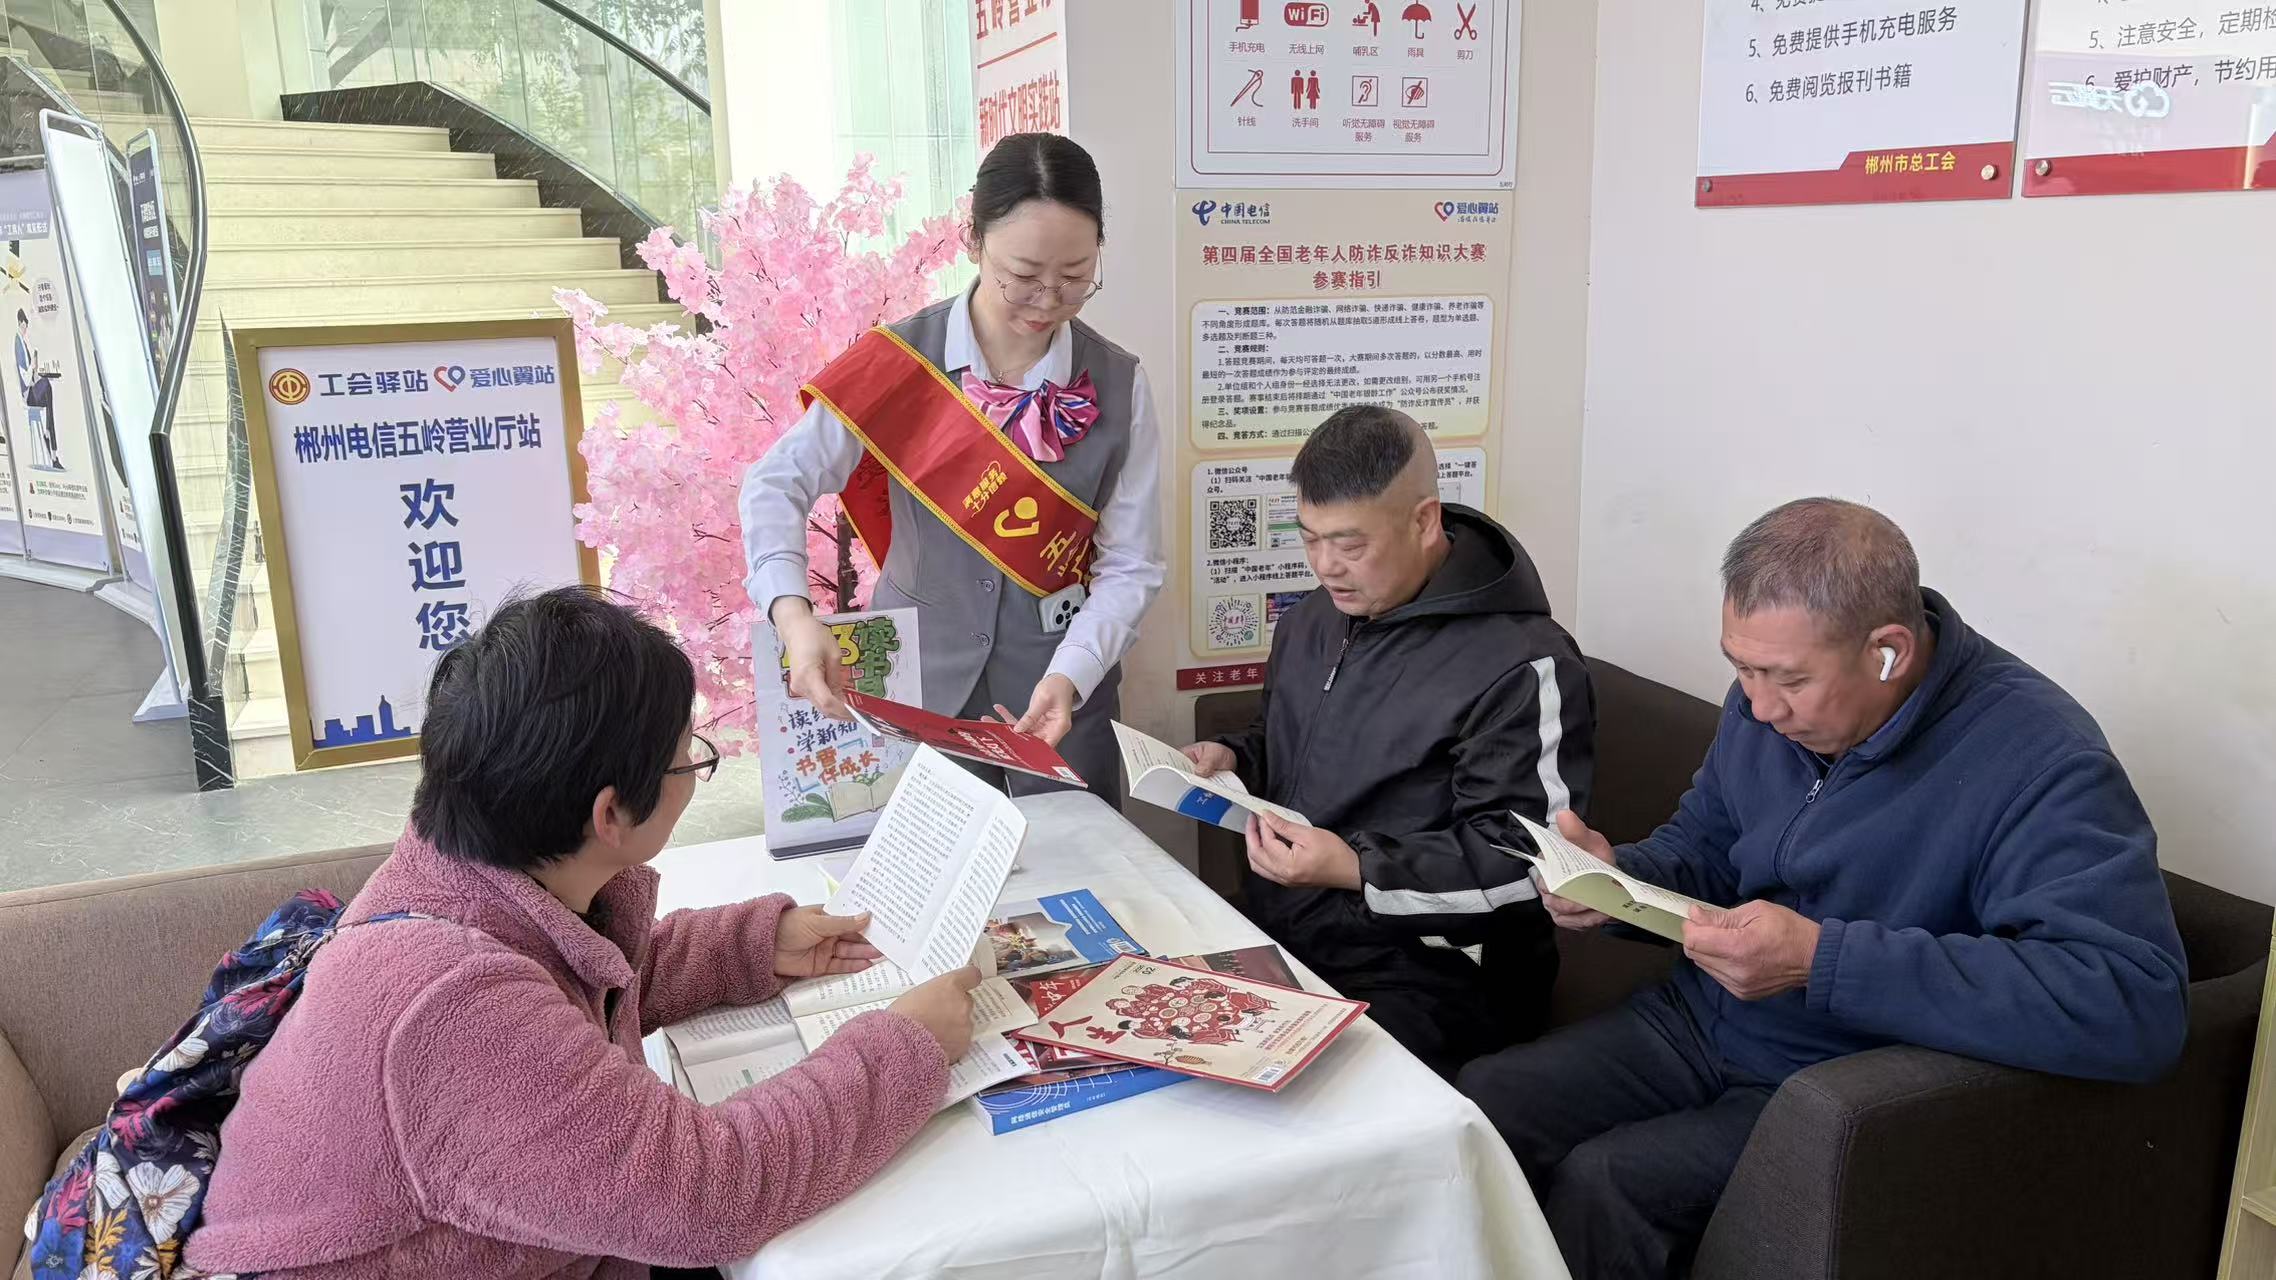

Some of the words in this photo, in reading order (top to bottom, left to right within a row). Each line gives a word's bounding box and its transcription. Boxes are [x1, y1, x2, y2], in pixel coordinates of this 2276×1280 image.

[1749, 6, 1958, 58] 5、免费提供手机充电服务
[1229, 41, 1265, 54] 手机充电
[1288, 43, 1325, 55] 无线上网
[1353, 46, 1379, 57] 哺乳区
[1407, 47, 1424, 58] 雨具
[1457, 50, 1474, 60] 剪刀
[1746, 63, 1913, 103] 6、免费阅览报刊书籍
[2085, 56, 2276, 93] 6爱护财产，节约用
[979, 70, 1060, 149] 新时代文明实践站
[1237, 116, 1256, 127] 针线
[1292, 118, 1319, 129] 洗手间
[1342, 118, 1385, 129] 听觉无障碍
[1393, 119, 1435, 129] 视觉无障碍
[1355, 132, 1372, 142] 服务
[1405, 132, 1422, 143] 服务
[1865, 151, 1956, 175] 郴州市总工会
[1220, 202, 1271, 219] 中国电信
[1202, 244, 1488, 264] 第四届全国老年人防诈反诈知识大赛
[1312, 270, 1382, 289] 参赛指引
[318, 369, 429, 397] 工会驿站
[469, 364, 556, 389] 爱心翼站
[294, 412, 542, 464] 郴州电信五岭营业厅站
[1437, 470, 1473, 479] 上答题平台。
[400, 478, 471, 651] 欢迎您
[797, 721, 858, 752] 学新知
[1048, 1014, 1129, 1044] 人生
